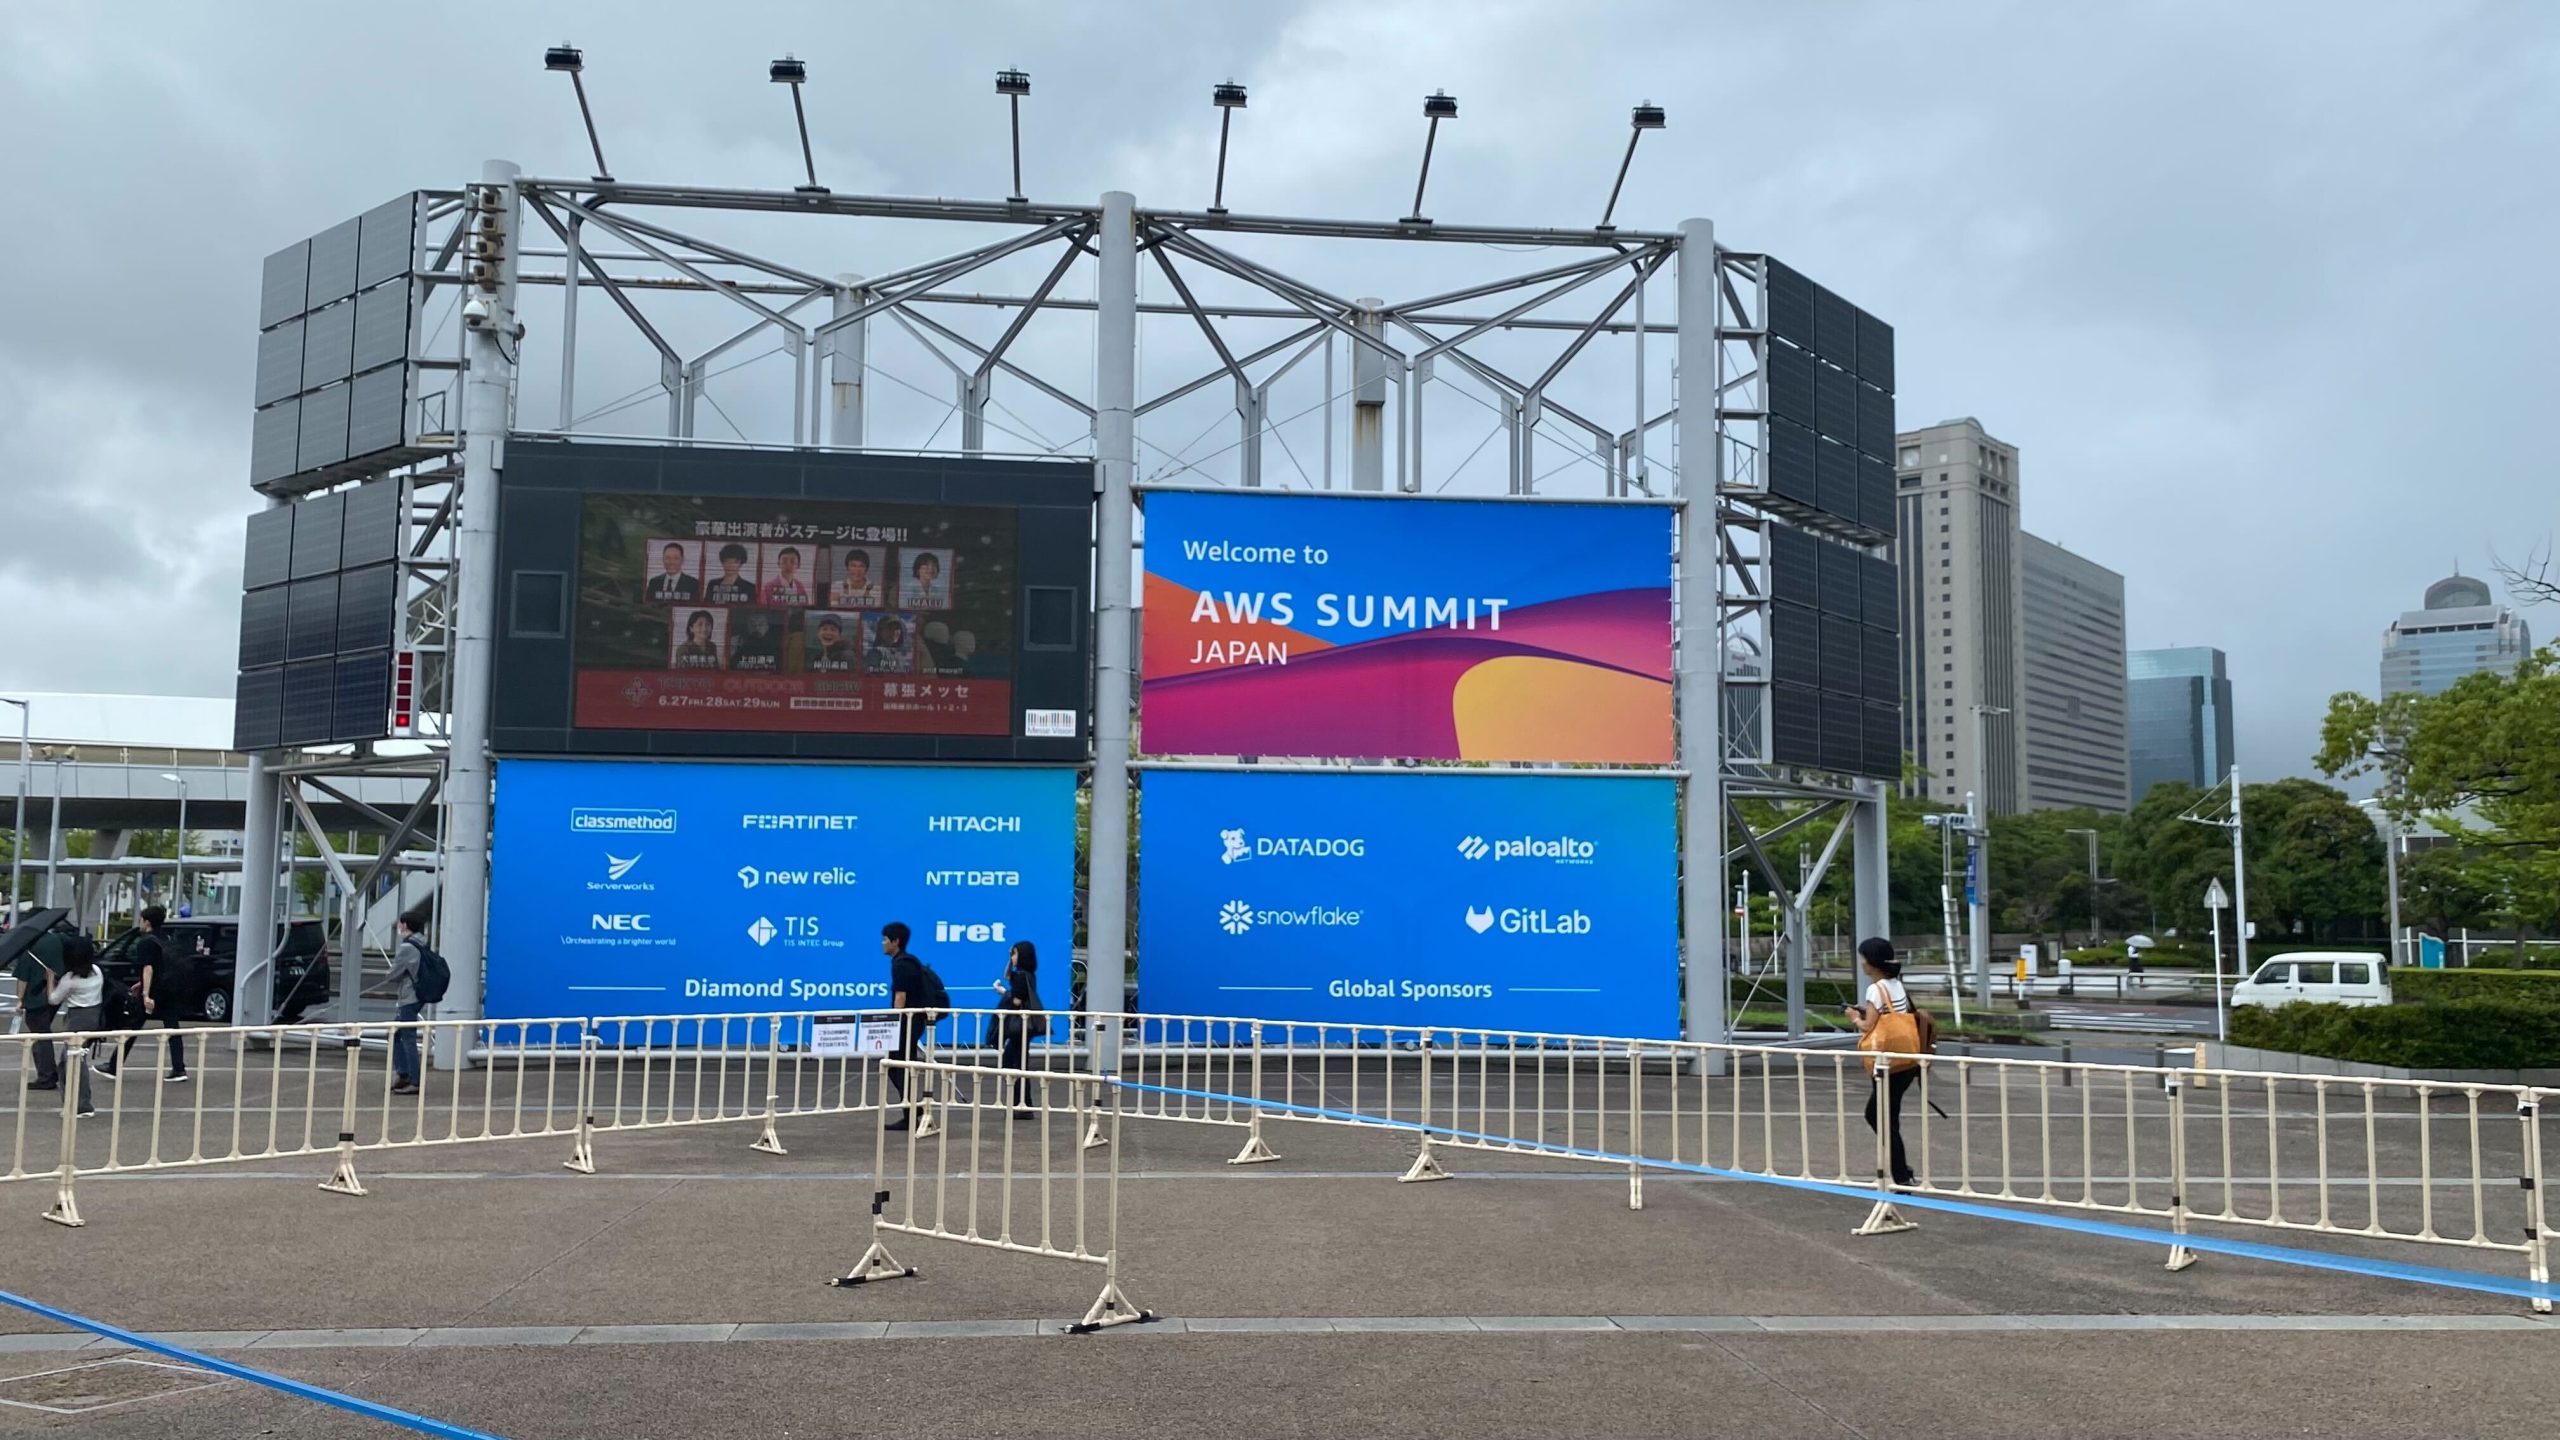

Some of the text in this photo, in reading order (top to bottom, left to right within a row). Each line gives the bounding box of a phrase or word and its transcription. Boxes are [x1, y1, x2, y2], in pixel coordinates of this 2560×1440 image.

[694, 519, 909, 543] 豪華出演者がステージに登場!!
[1183, 539, 1329, 565] Welcome to
[1190, 590, 1509, 632] AWS SUMMIT
[1189, 639, 1288, 666] JAPAN
[883, 682, 969, 698] 幕張メッセ
[574, 814, 673, 830] classmethod
[743, 814, 857, 830] FORTINET
[929, 816, 1021, 832] HITACHI
[1257, 837, 1365, 858] DATADOG
[1495, 836, 1594, 862] paloalto
[587, 880, 655, 892] Serverworks
[765, 866, 856, 886] new relic
[592, 914, 651, 931] NEC
[784, 916, 819, 936] TIS
[1257, 904, 1360, 927] snowflake
[1500, 908, 1591, 934] GitLab
[935, 920, 1006, 942] iret
[623, 937, 652, 947] brighter
[655, 938, 676, 946] world
[784, 939, 845, 949] TIS INTEC Group
[685, 978, 888, 1002] Diamond Sponsors
[1329, 978, 1493, 1002] Global Sponsors
